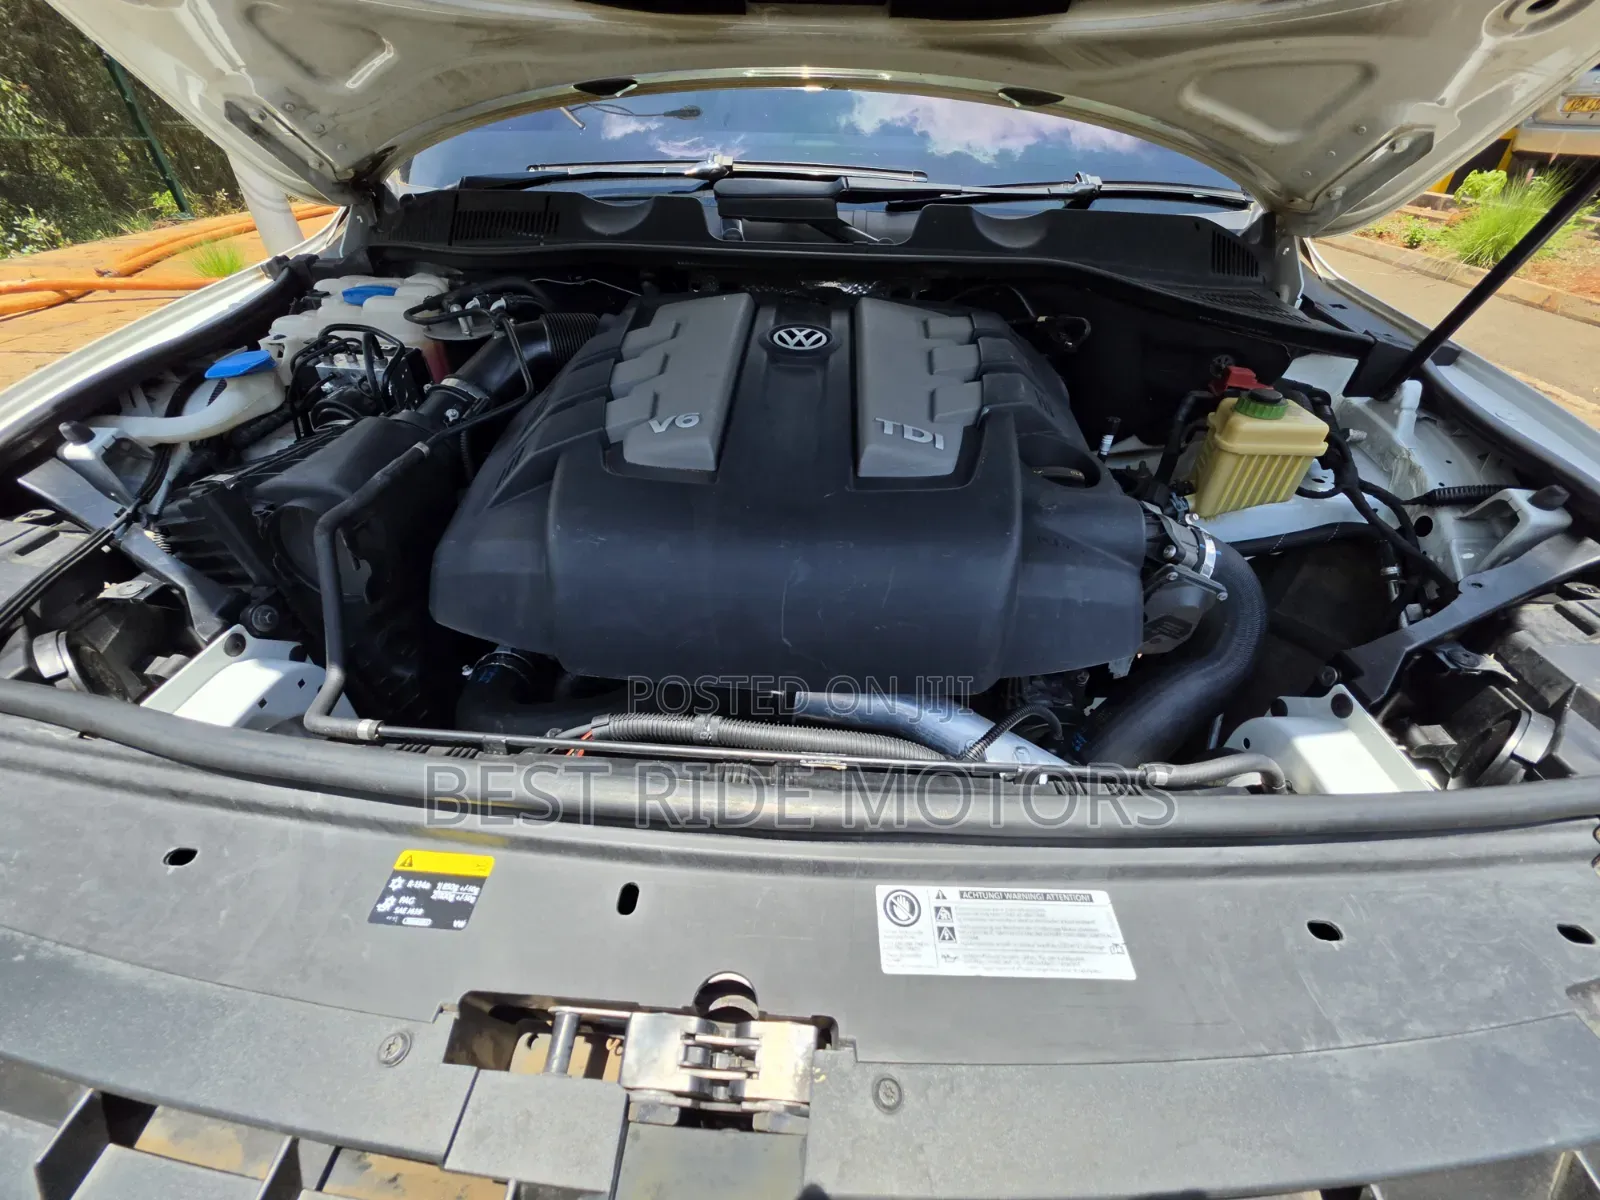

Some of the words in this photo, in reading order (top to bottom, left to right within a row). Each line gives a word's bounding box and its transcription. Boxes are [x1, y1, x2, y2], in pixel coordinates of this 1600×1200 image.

[649, 412, 701, 434] V6
[874, 417, 945, 450] TDI
[962, 891, 1003, 900] ACHTUNG!
[1004, 893, 1045, 901] WARNING!
[1046, 894, 1091, 902] ATTENTION!
